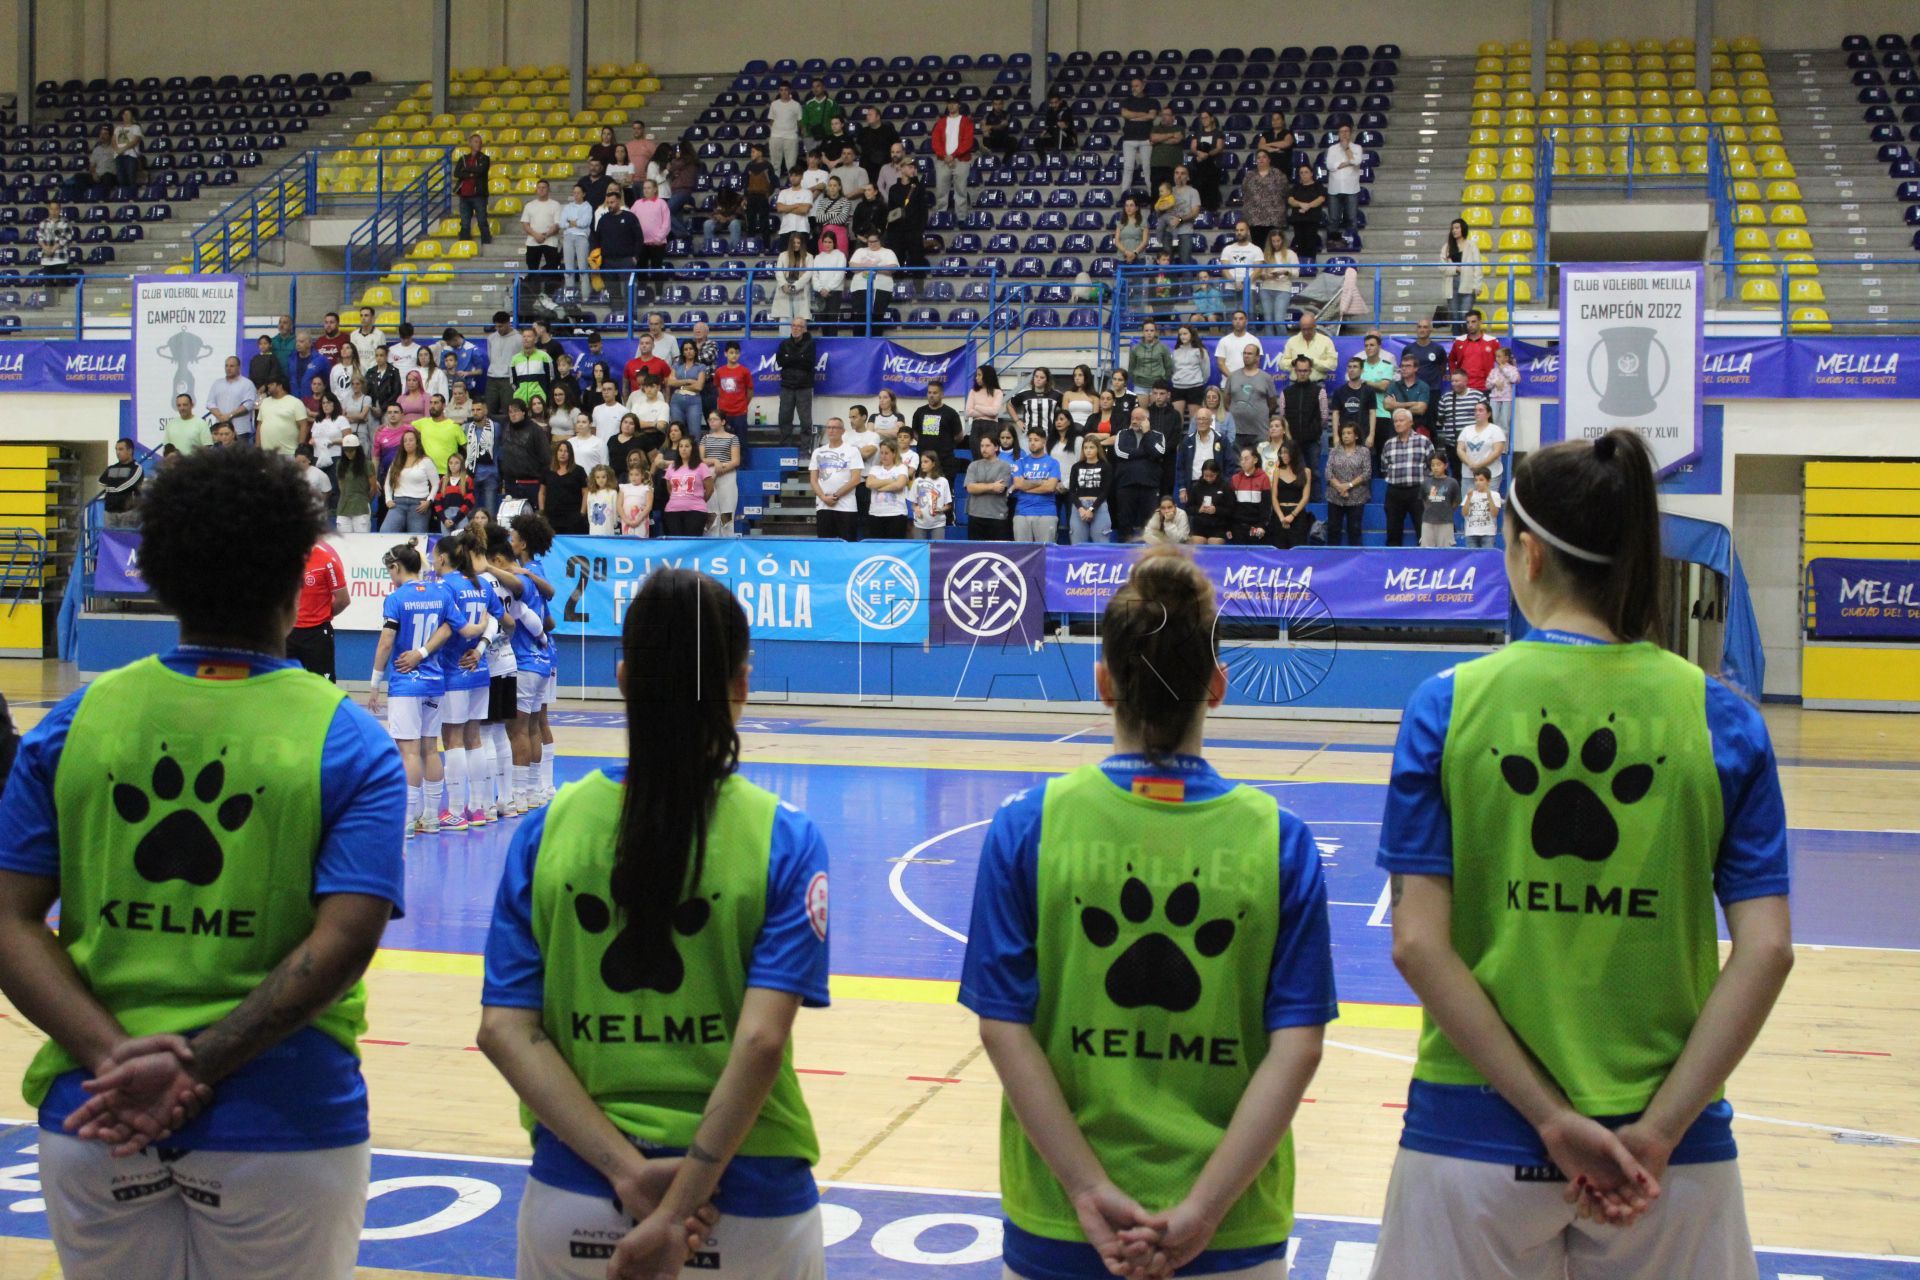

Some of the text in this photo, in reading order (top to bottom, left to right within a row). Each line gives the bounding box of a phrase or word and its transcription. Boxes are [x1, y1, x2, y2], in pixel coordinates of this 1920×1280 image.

[142, 288, 234, 299] CLUB VOLEIBOL MELILLA
[1574, 278, 1692, 292] CLUB VOLEIBOL MELILLA
[147, 306, 226, 325] CAMPEÓN 2022
[1580, 300, 1682, 320] CAMPEÓN 2022
[65, 353, 127, 373] MELILLA
[882, 354, 951, 375] MELILLA
[1702, 352, 1753, 374] LILLA
[1816, 352, 1899, 375] MELILLA
[1655, 426, 1679, 439] XLVII
[614, 552, 811, 578] DIVISIÓN
[1223, 565, 1313, 588] MELILLA
[1384, 566, 1477, 591] MELILLA
[459, 589, 487, 599] JANE
[1435, 593, 1474, 603] DEPORTE
[738, 582, 813, 629] SALA
[1841, 606, 1880, 618] CIUDAD
[1883, 607, 1902, 618] DEL
[412, 613, 439, 650] 10
[1507, 880, 1659, 919] KELME
[99, 900, 256, 938] KELME
[571, 1011, 726, 1045] KELME
[1071, 1025, 1240, 1067] KELME
